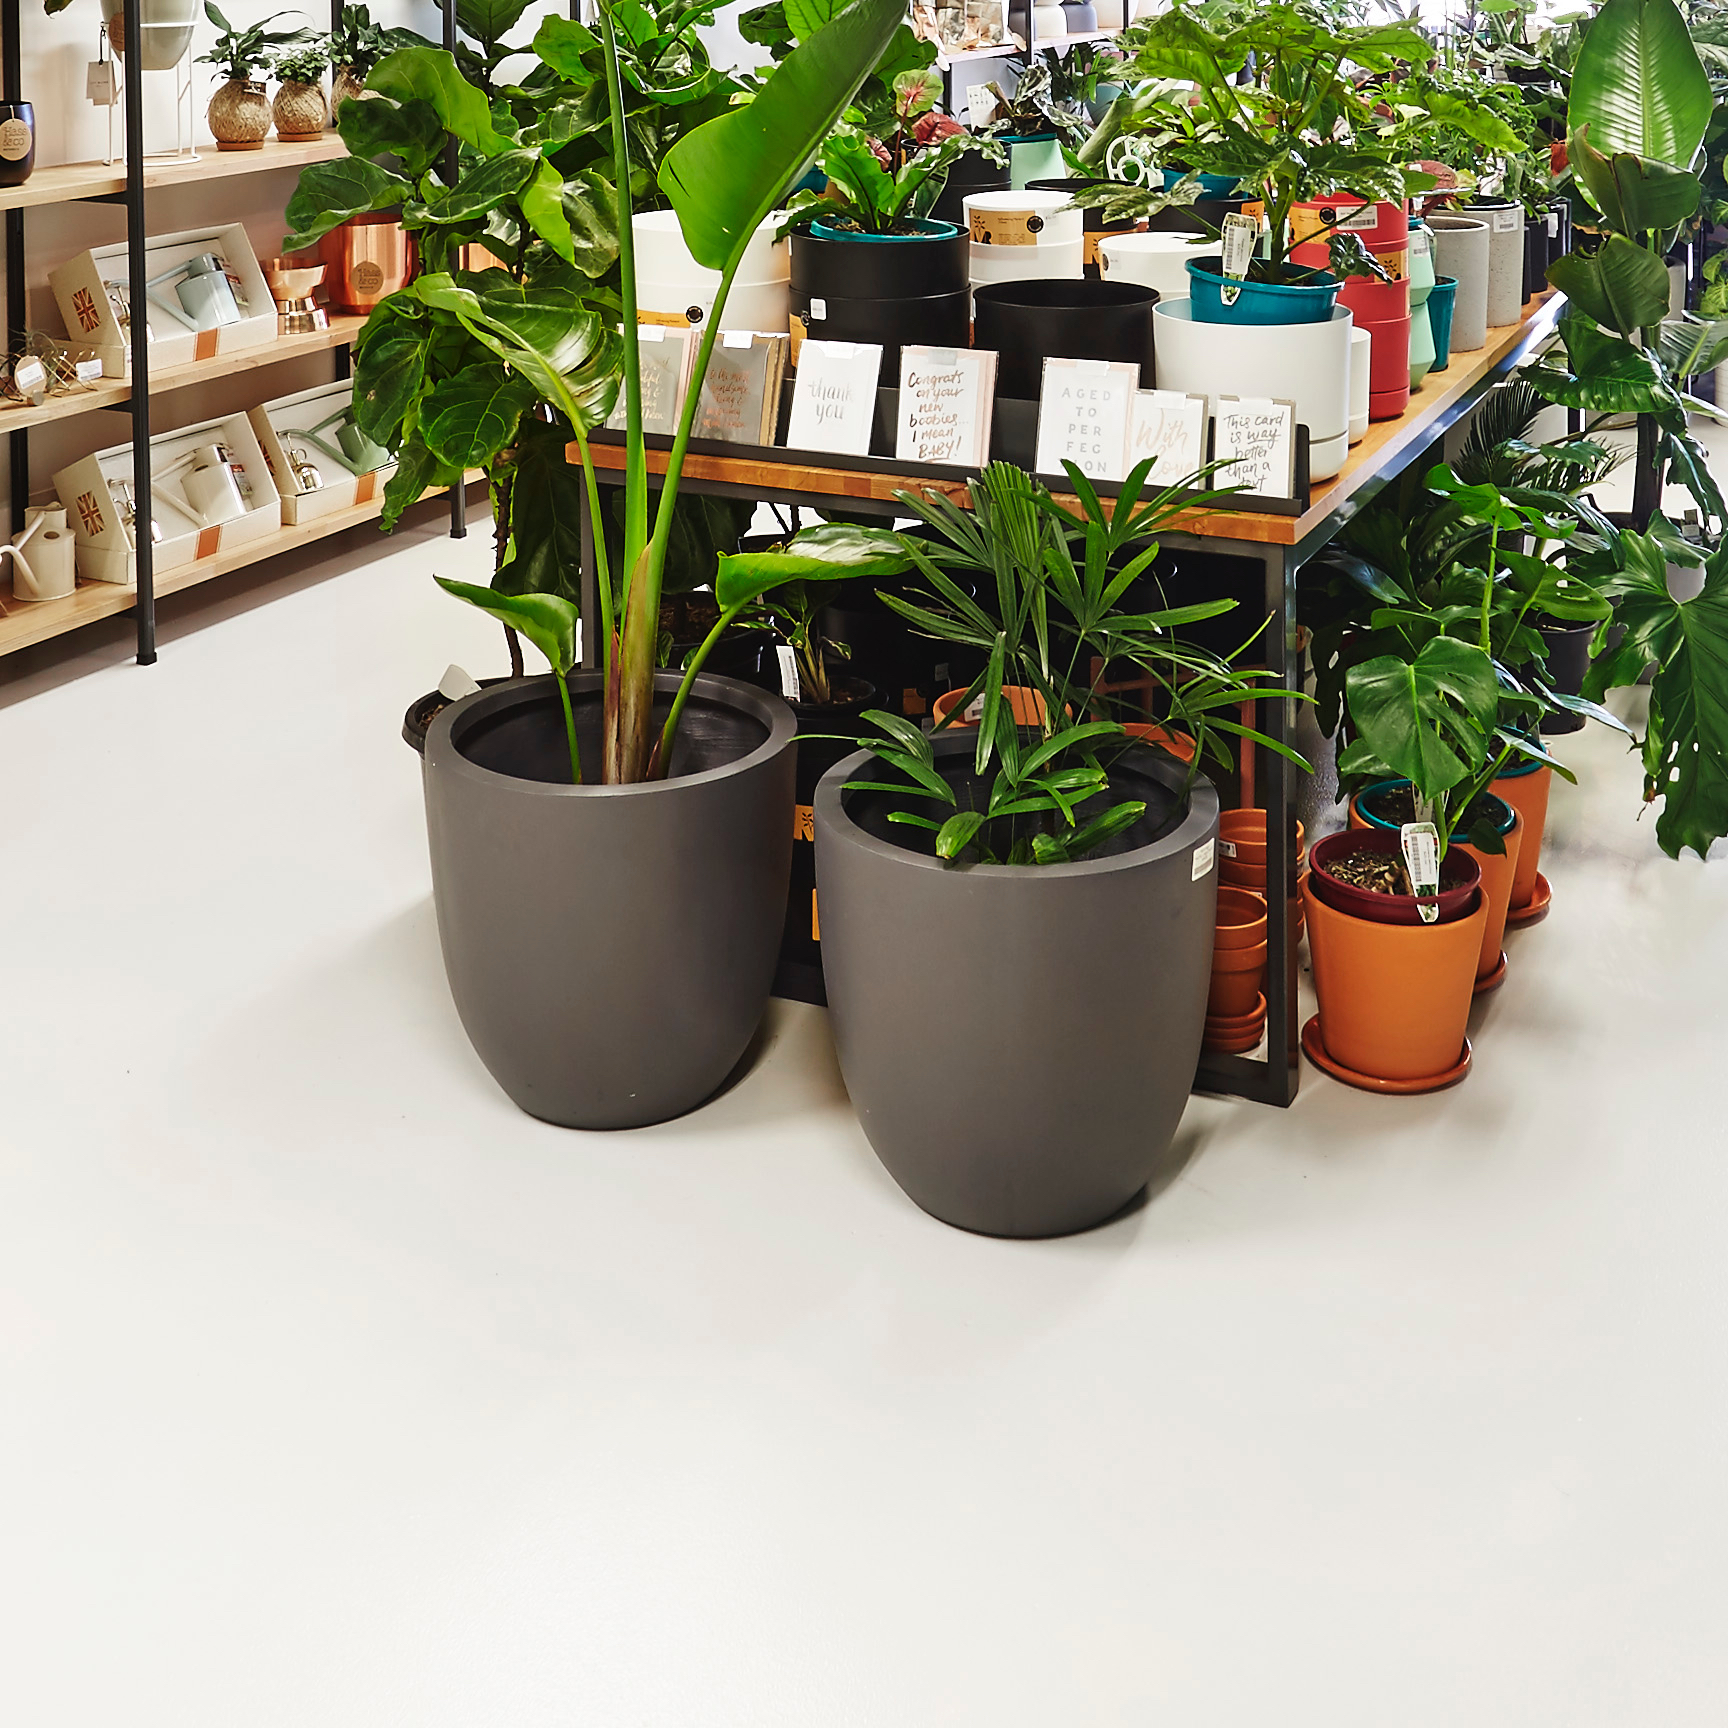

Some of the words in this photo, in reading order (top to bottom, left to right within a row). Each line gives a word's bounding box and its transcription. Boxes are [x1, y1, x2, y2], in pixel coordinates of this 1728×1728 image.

[907, 370, 964, 388] Congrats
[808, 378, 853, 402] thank
[916, 389, 931, 398] on
[933, 387, 963, 402] your
[1061, 387, 1112, 401] AGED
[815, 403, 844, 424] you
[919, 402, 944, 412] new
[1075, 406, 1097, 417] TO
[1223, 414, 1250, 429] This
[1254, 411, 1285, 427] card
[922, 428, 954, 440] mean
[1068, 423, 1102, 436] PER
[1136, 408, 1189, 454] With
[1229, 431, 1243, 444] is
[1246, 428, 1281, 450] way
[918, 436, 962, 460] BABY!
[1234, 446, 1269, 461] better
[1224, 462, 1257, 479] than
[1261, 462, 1272, 473] a
